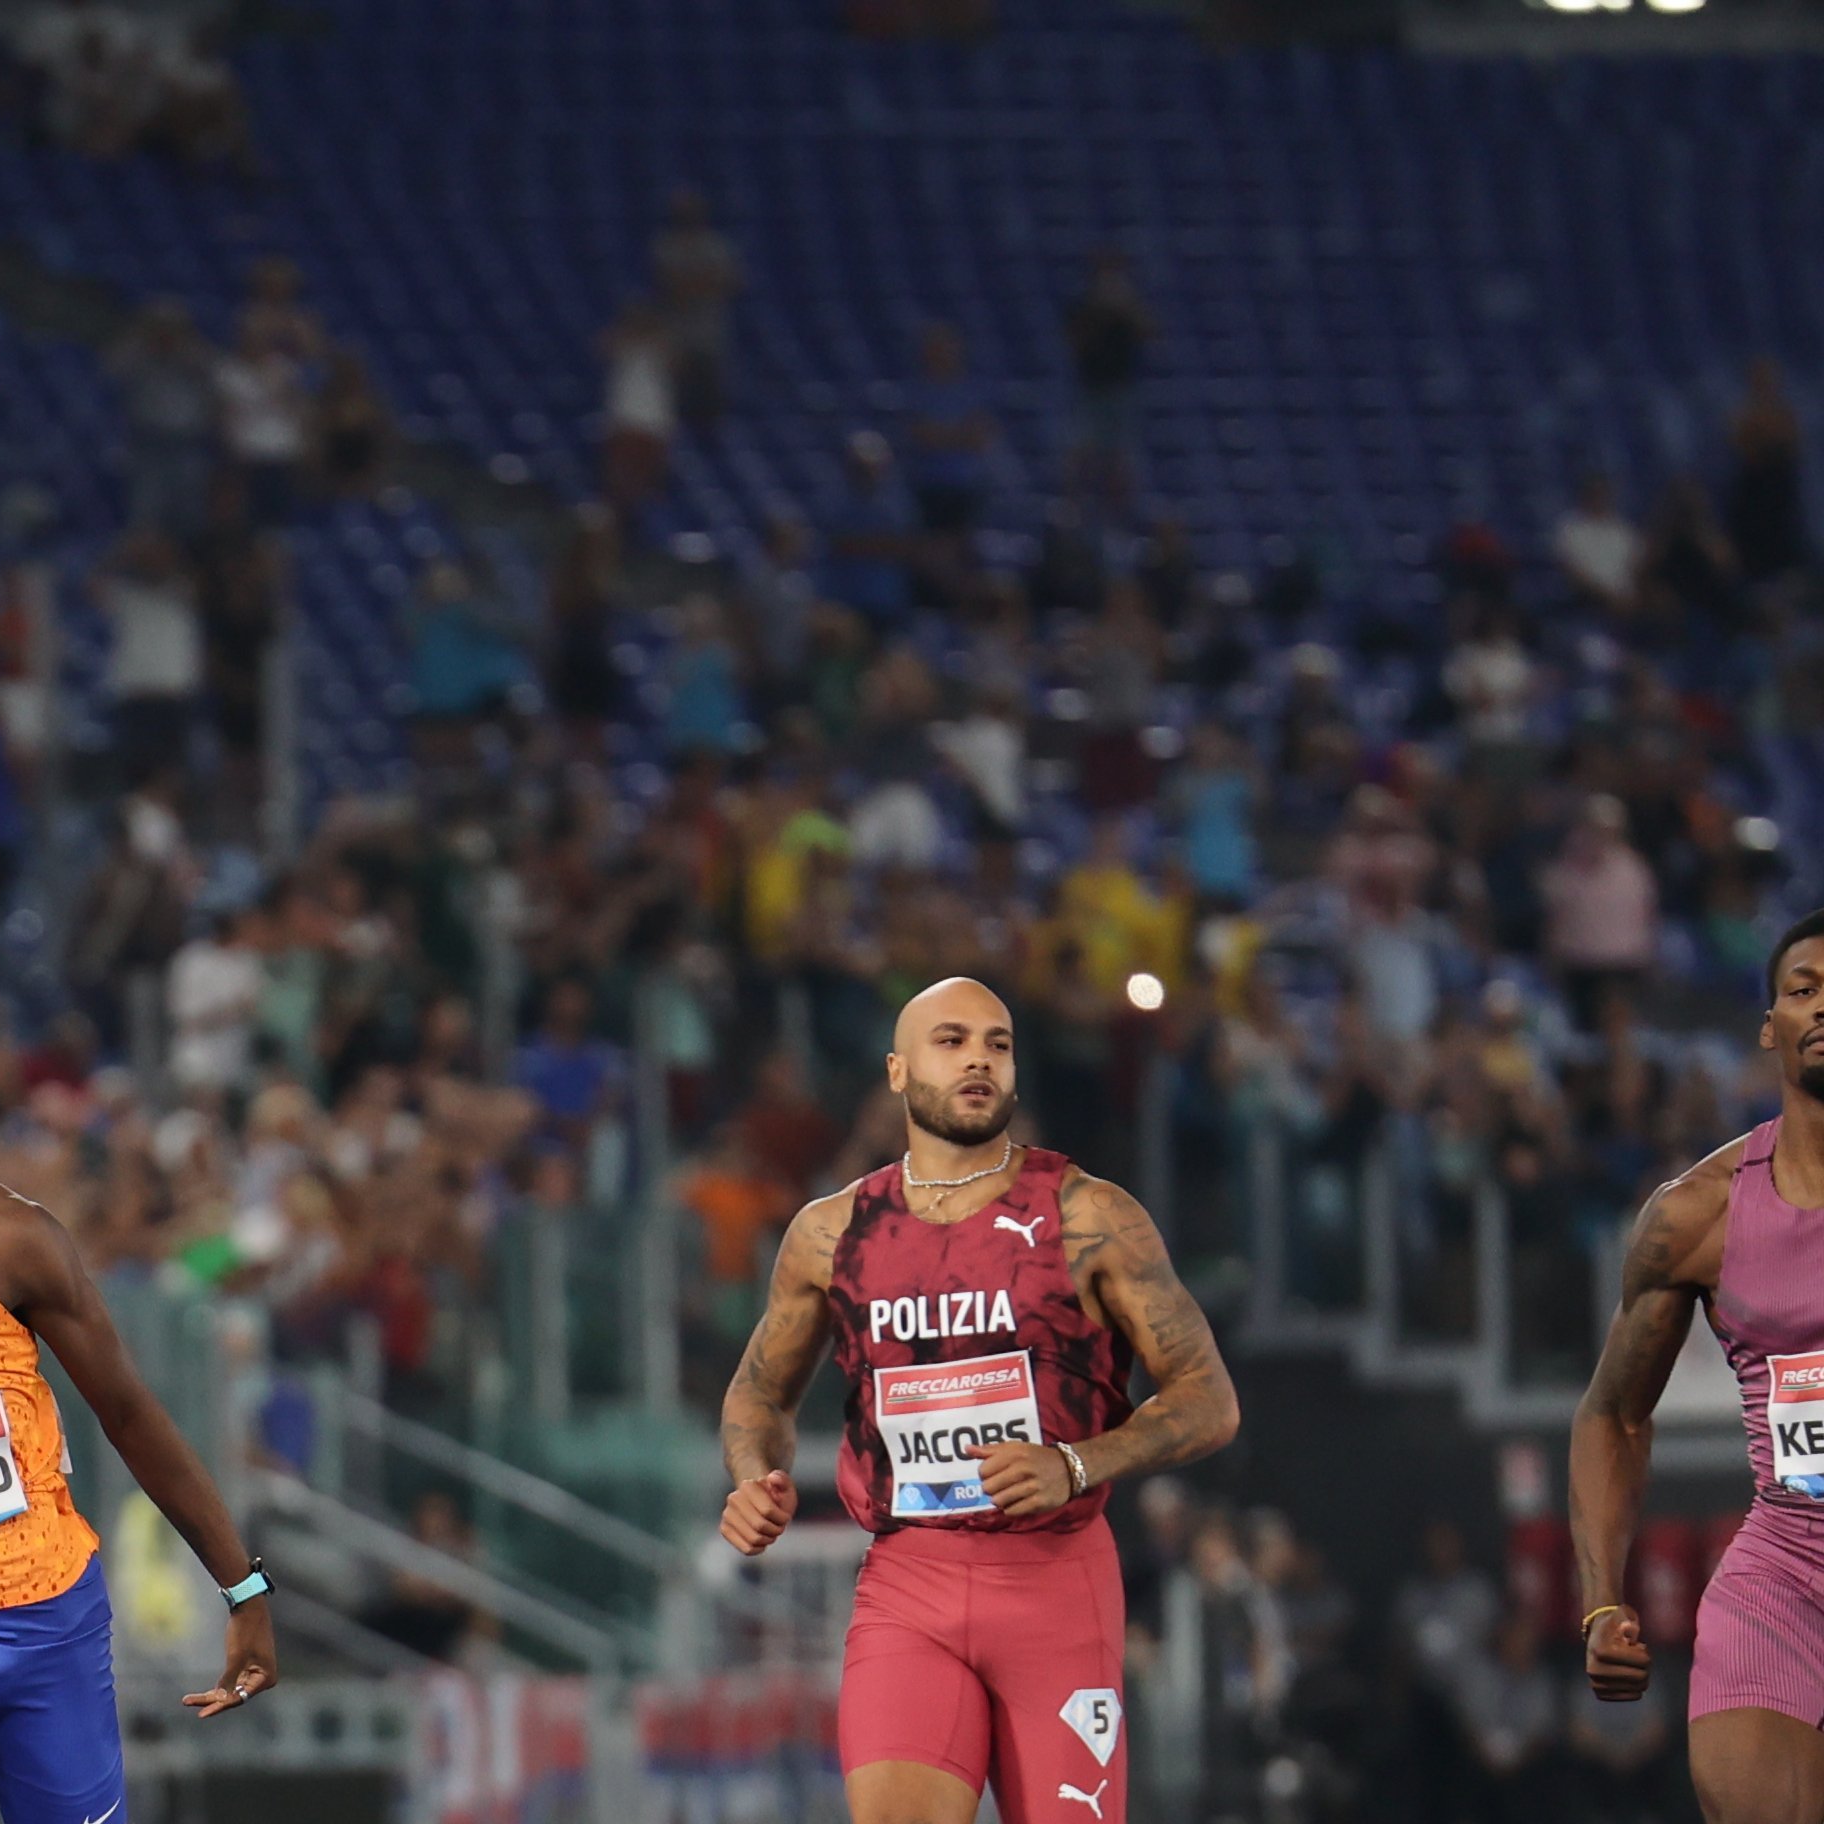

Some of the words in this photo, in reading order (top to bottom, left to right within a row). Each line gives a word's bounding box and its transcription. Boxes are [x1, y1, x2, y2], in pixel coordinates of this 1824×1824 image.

[870, 1289, 1016, 1343] POLIZIA
[888, 1367, 1021, 1397] FRECCIAROSSA
[1093, 1700, 1109, 1735] 5
